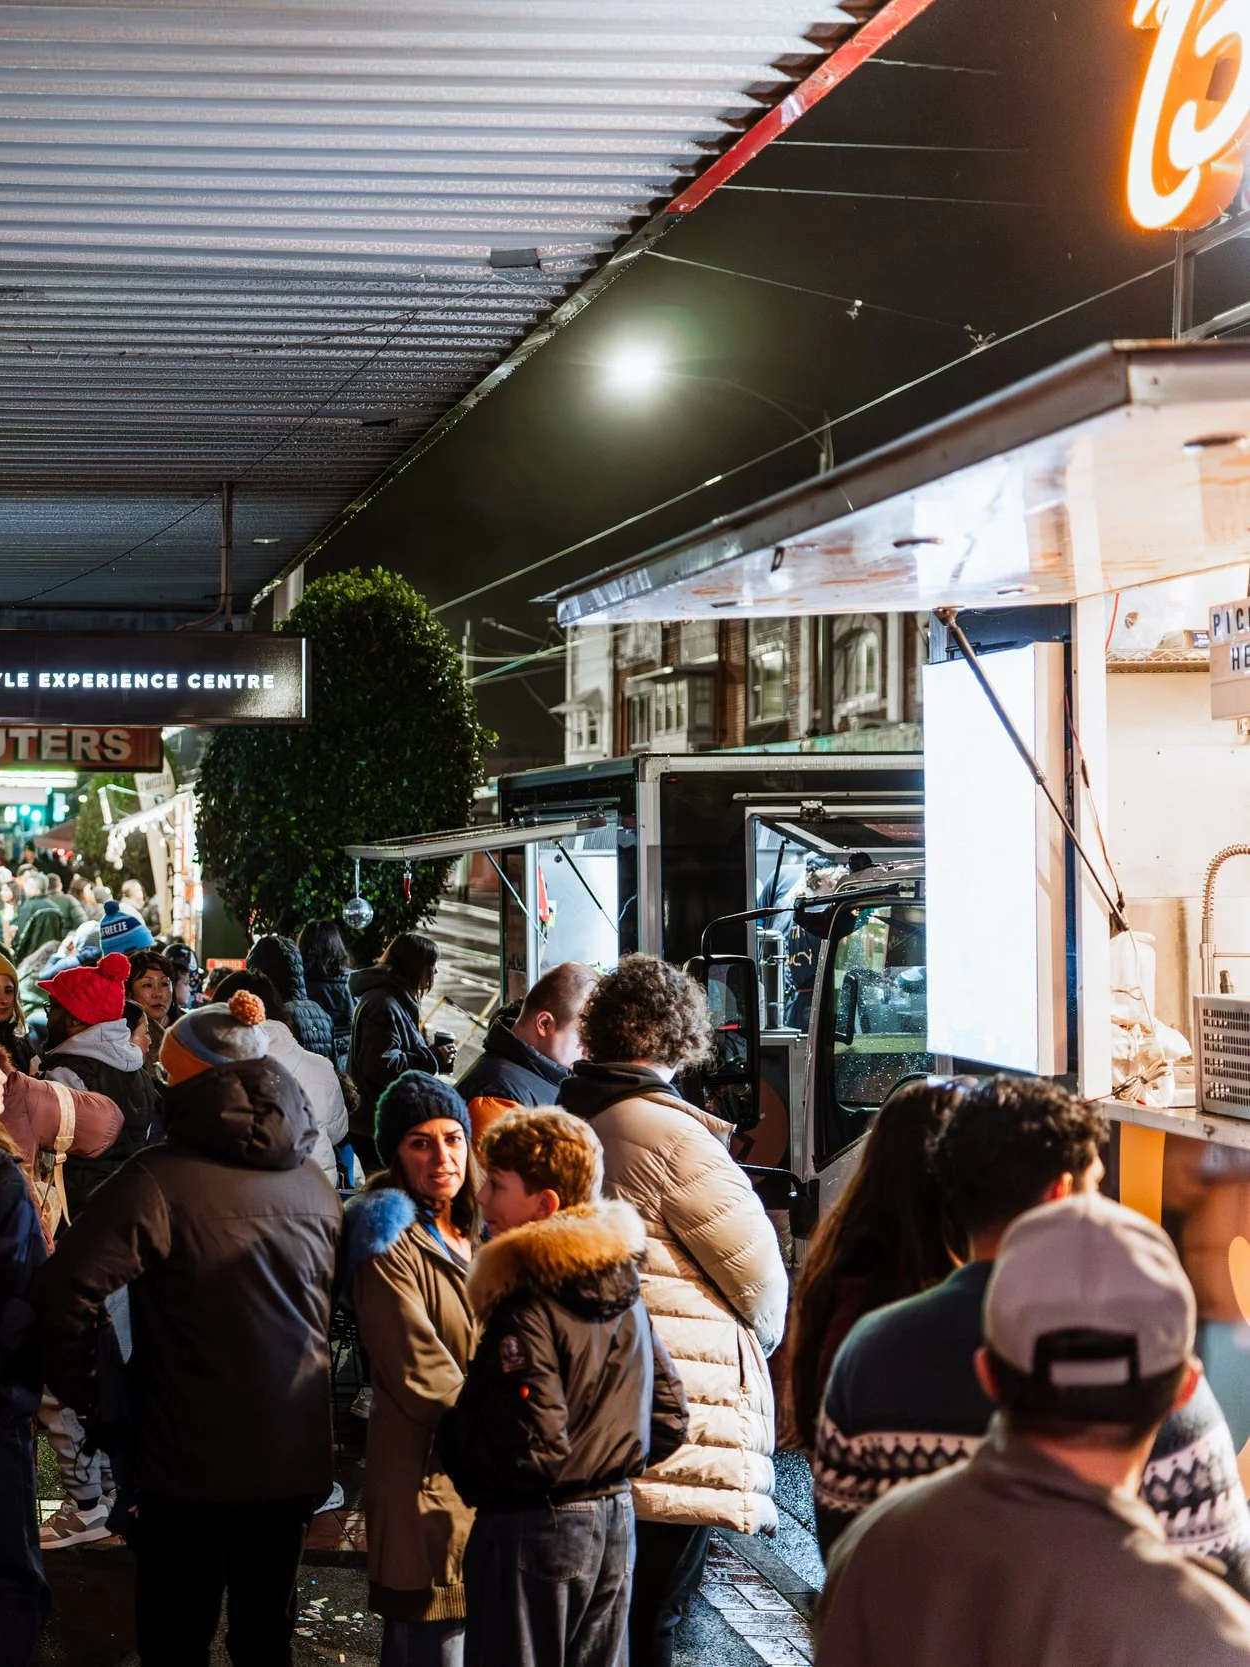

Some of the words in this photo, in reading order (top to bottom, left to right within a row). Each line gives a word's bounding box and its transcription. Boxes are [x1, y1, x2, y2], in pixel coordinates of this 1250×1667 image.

[1213, 606, 1250, 636] PIC
[39, 673, 178, 688] EXPERIENCE
[187, 674, 274, 689] CENTRE
[101, 921, 129, 936] FREEZE
